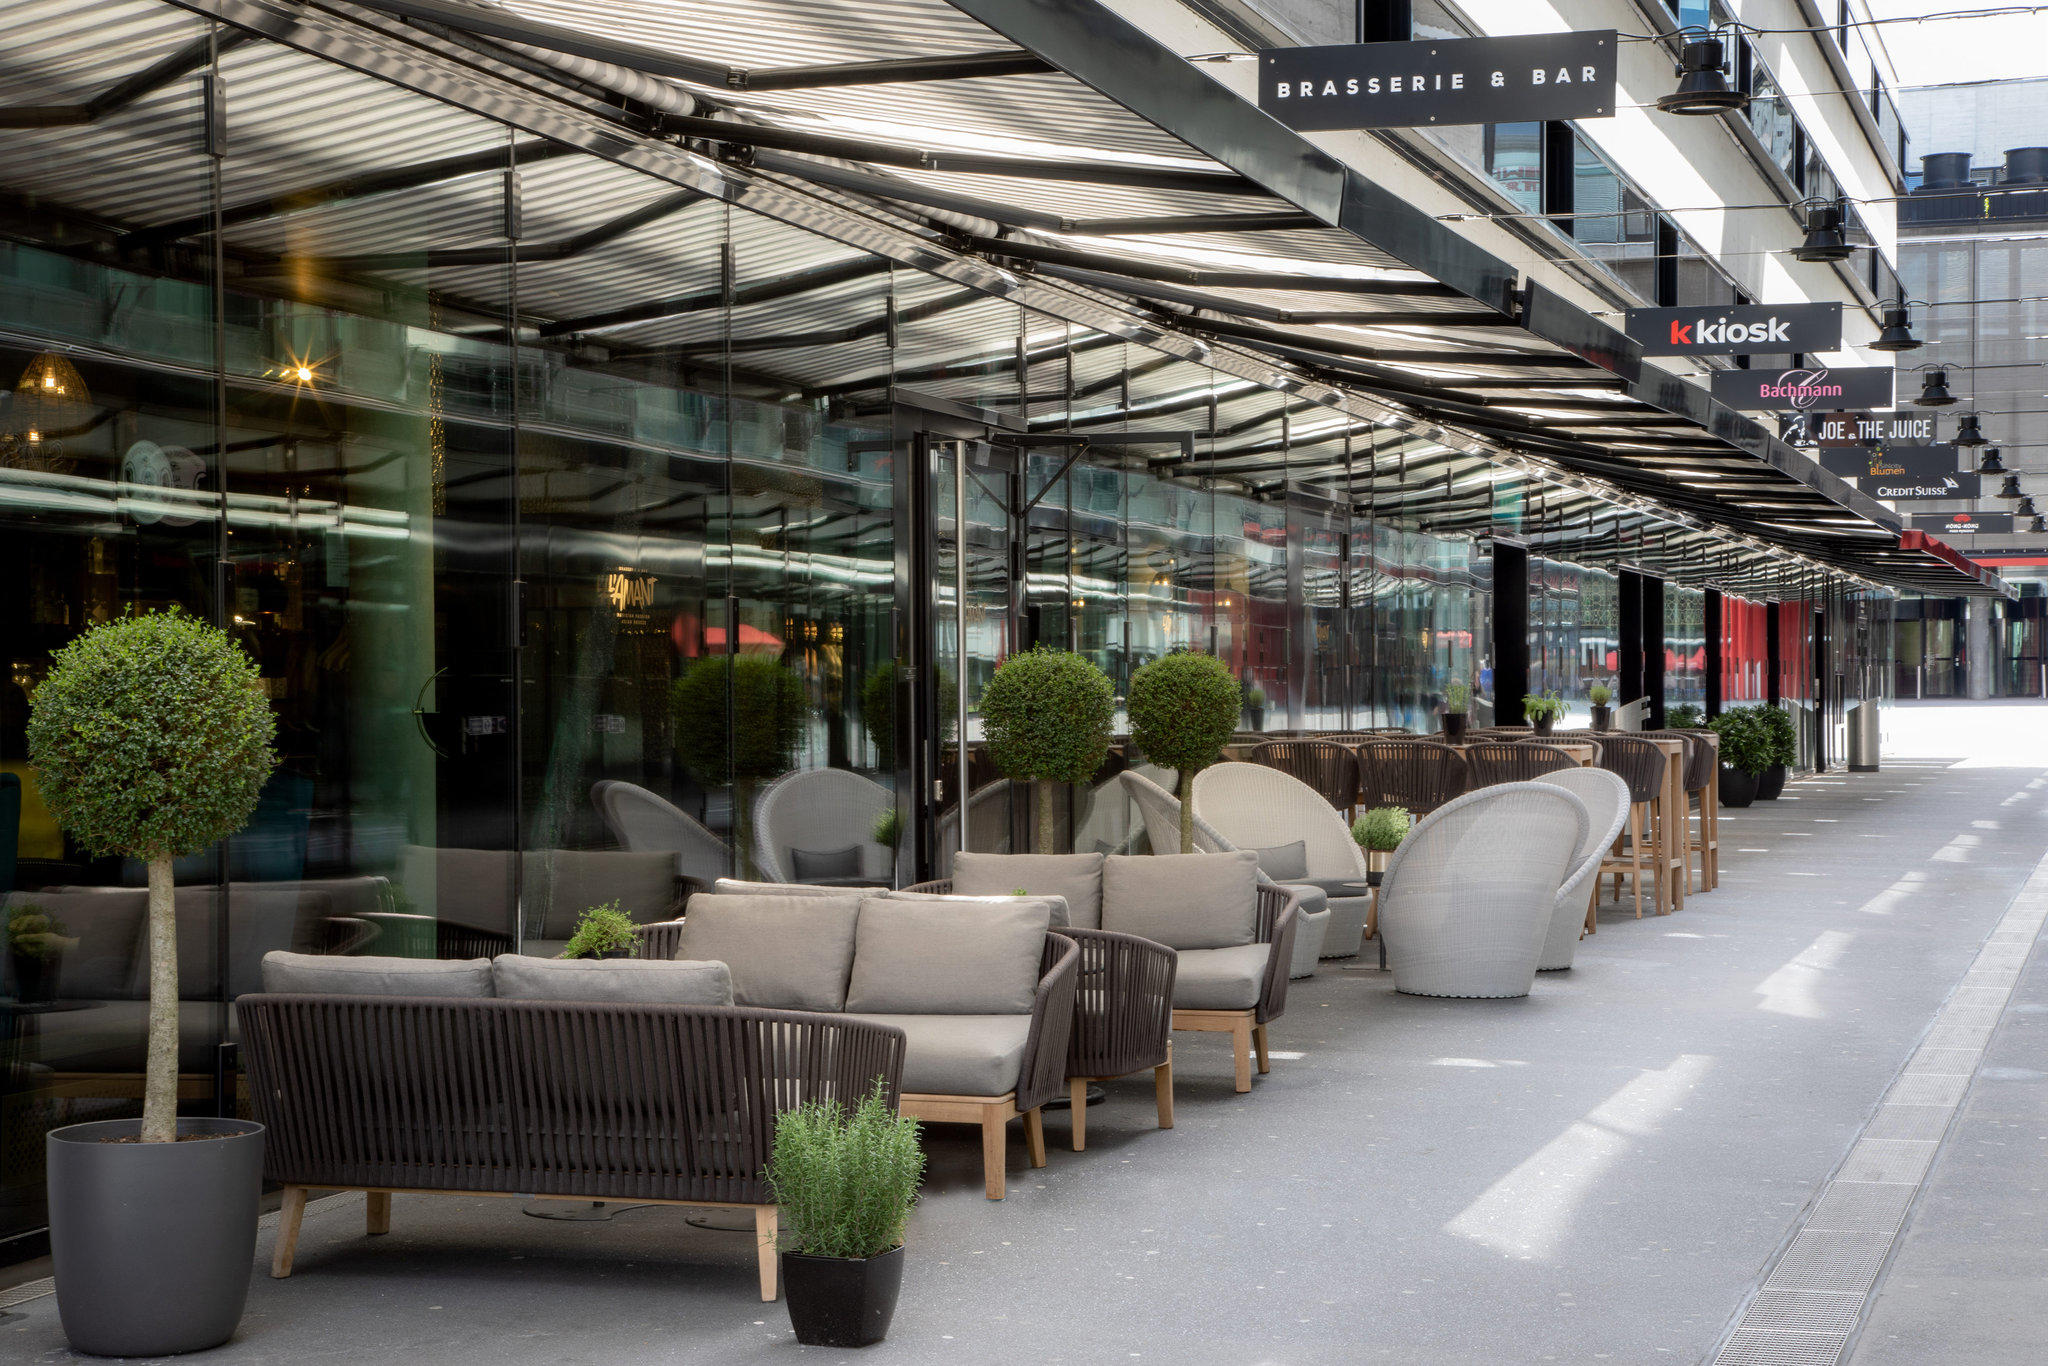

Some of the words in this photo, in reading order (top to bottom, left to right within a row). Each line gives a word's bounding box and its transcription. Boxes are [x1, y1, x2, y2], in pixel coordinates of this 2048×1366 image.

[1277, 74, 1464, 98] BRASSERIE
[1490, 71, 1505, 87] &
[1532, 65, 1596, 85] BAR
[1760, 382, 1842, 398] Bachmann
[1818, 421, 1846, 440] JOE
[1857, 420, 1885, 439] THE
[1889, 419, 1932, 440] JUICE
[1869, 464, 1905, 475] Blumen
[1877, 487, 1914, 497] CREDIT
[1915, 486, 1948, 496] SUISSE
